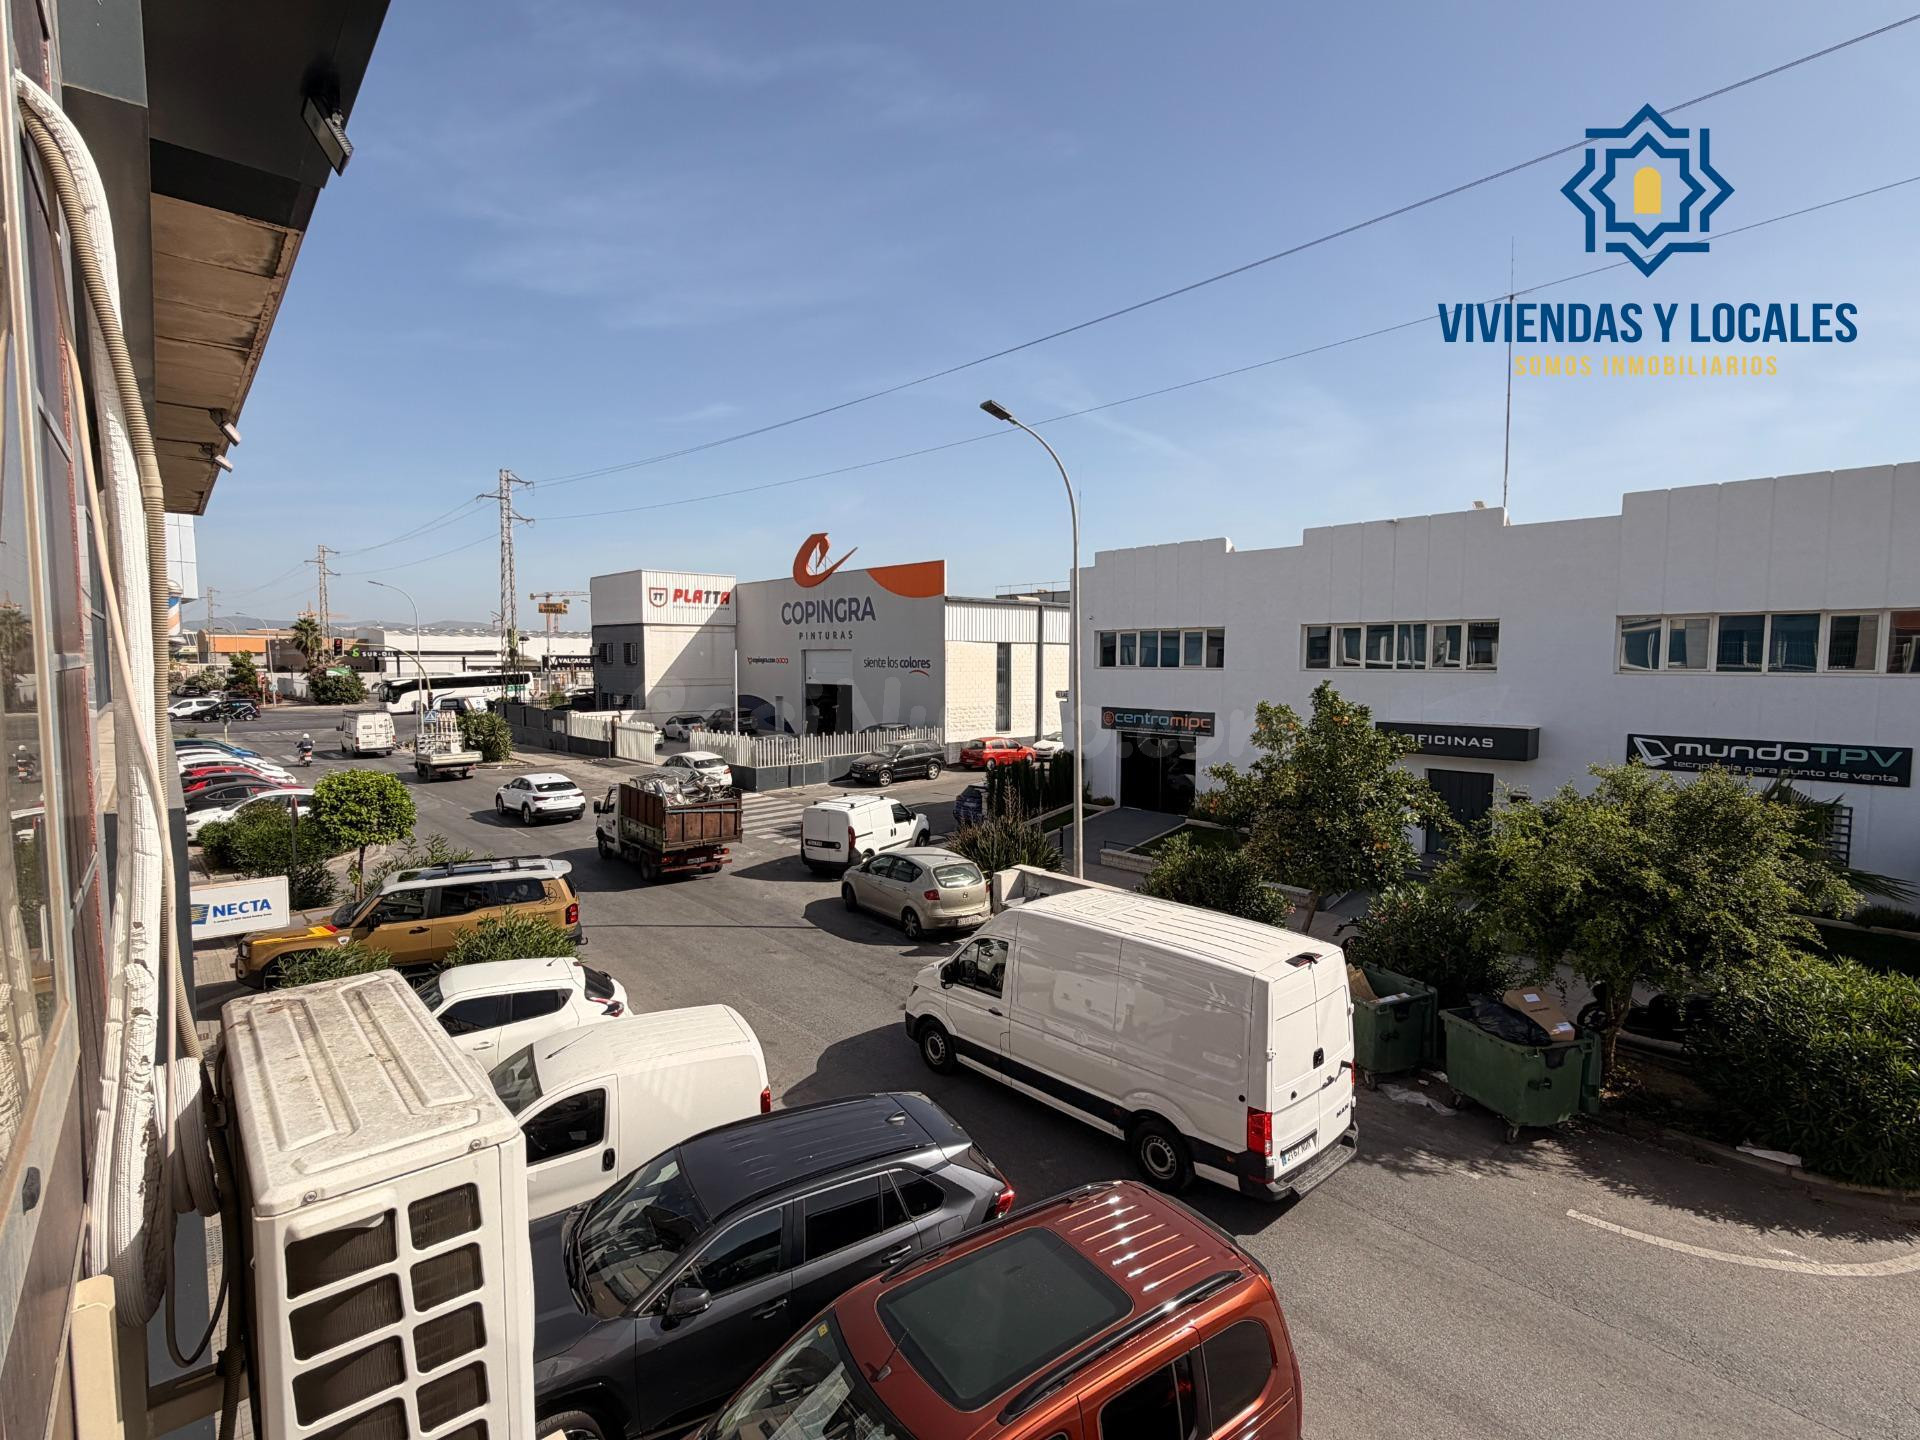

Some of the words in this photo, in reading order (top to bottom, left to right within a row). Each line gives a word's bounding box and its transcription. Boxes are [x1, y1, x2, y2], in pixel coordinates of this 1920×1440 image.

[672, 588, 731, 605] PLATTA
[781, 596, 877, 625] COPINGRA
[799, 630, 854, 640] PINTURAS
[863, 657, 887, 668] siente
[887, 656, 899, 668] los
[899, 656, 931, 669] colores
[1115, 712, 1211, 731] centromipc
[1674, 742, 1903, 768] mundoTPV
[1673, 760, 1742, 772] tecnolgía
[1781, 768, 1826, 777] punto
[1829, 770, 1849, 779] de
[1853, 773, 1899, 783] venta
[212, 898, 272, 918] NECTA
